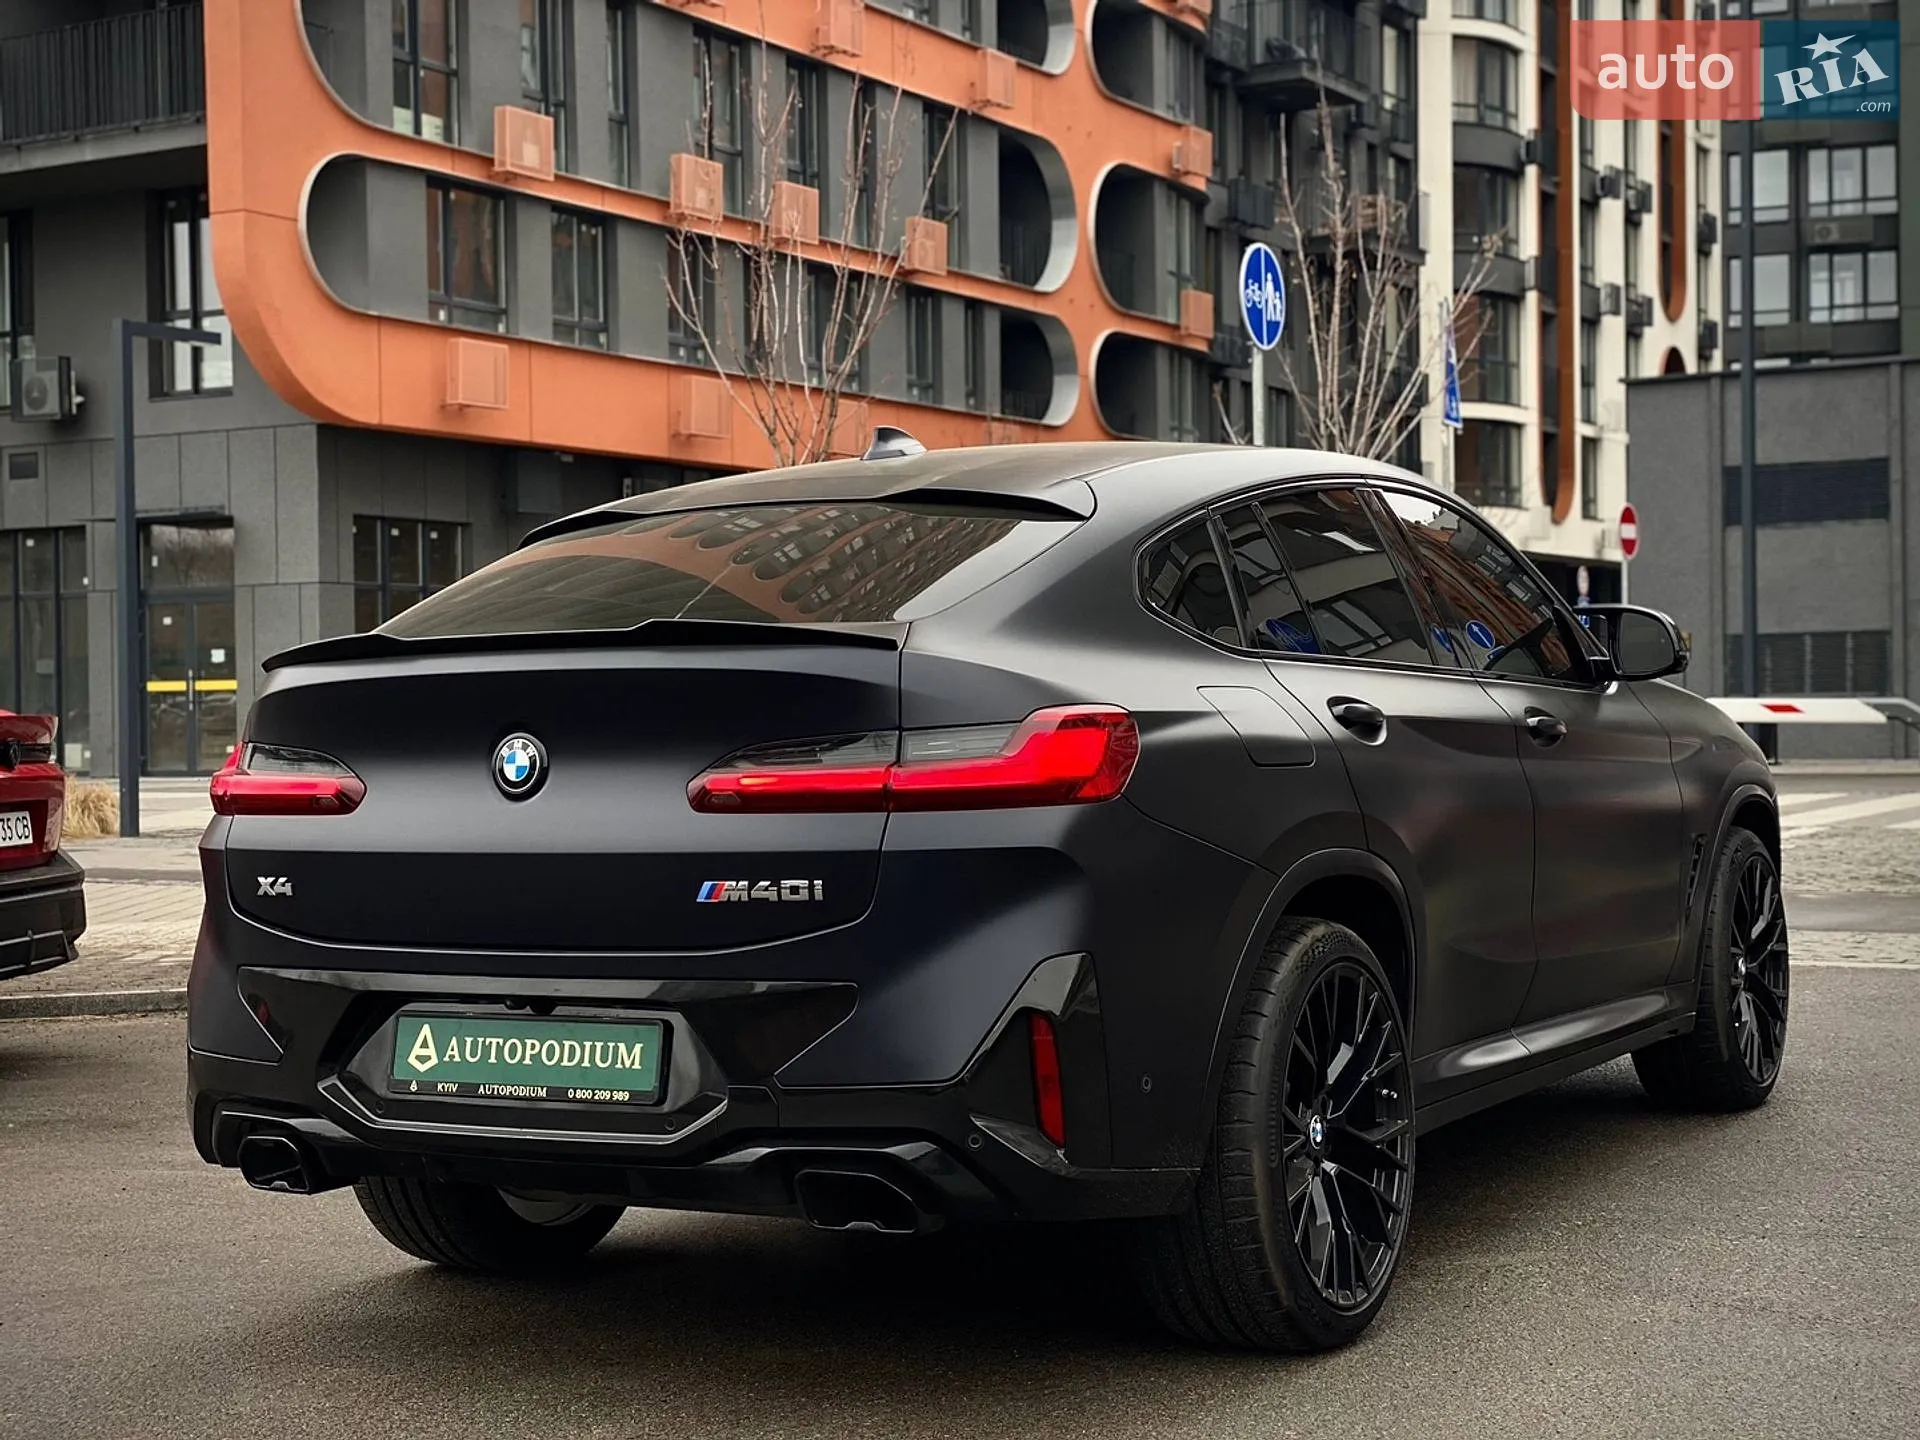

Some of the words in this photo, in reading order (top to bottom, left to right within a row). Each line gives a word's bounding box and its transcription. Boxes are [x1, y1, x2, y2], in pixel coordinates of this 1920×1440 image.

[257, 876, 293, 896] X4
[443, 1036, 644, 1069] AUTOPODIUM
[437, 1082, 459, 1093] KYIV
[477, 1084, 547, 1098] AUTOPODIUM
